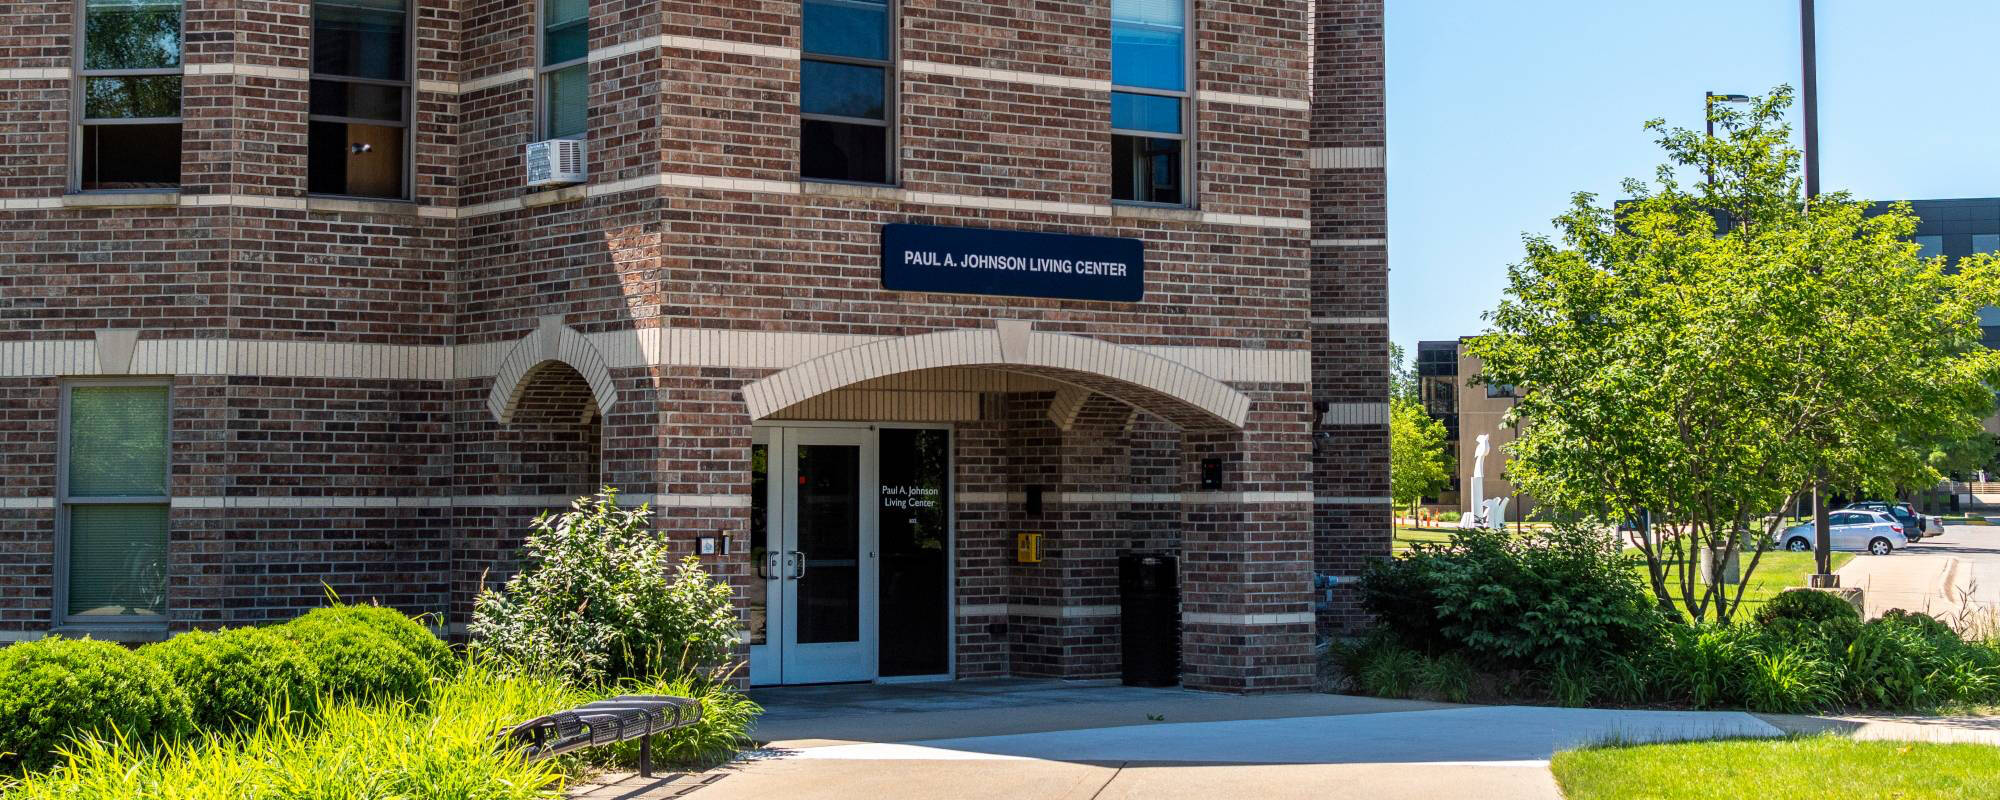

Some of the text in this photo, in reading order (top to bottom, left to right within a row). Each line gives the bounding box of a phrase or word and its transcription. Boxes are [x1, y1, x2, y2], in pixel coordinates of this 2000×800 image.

[904, 250, 1127, 277] PAUL A. JOHNSON LIVING CENTER
[882, 485, 939, 497] Paul A. Johnson
[884, 497, 936, 509] Living Center
